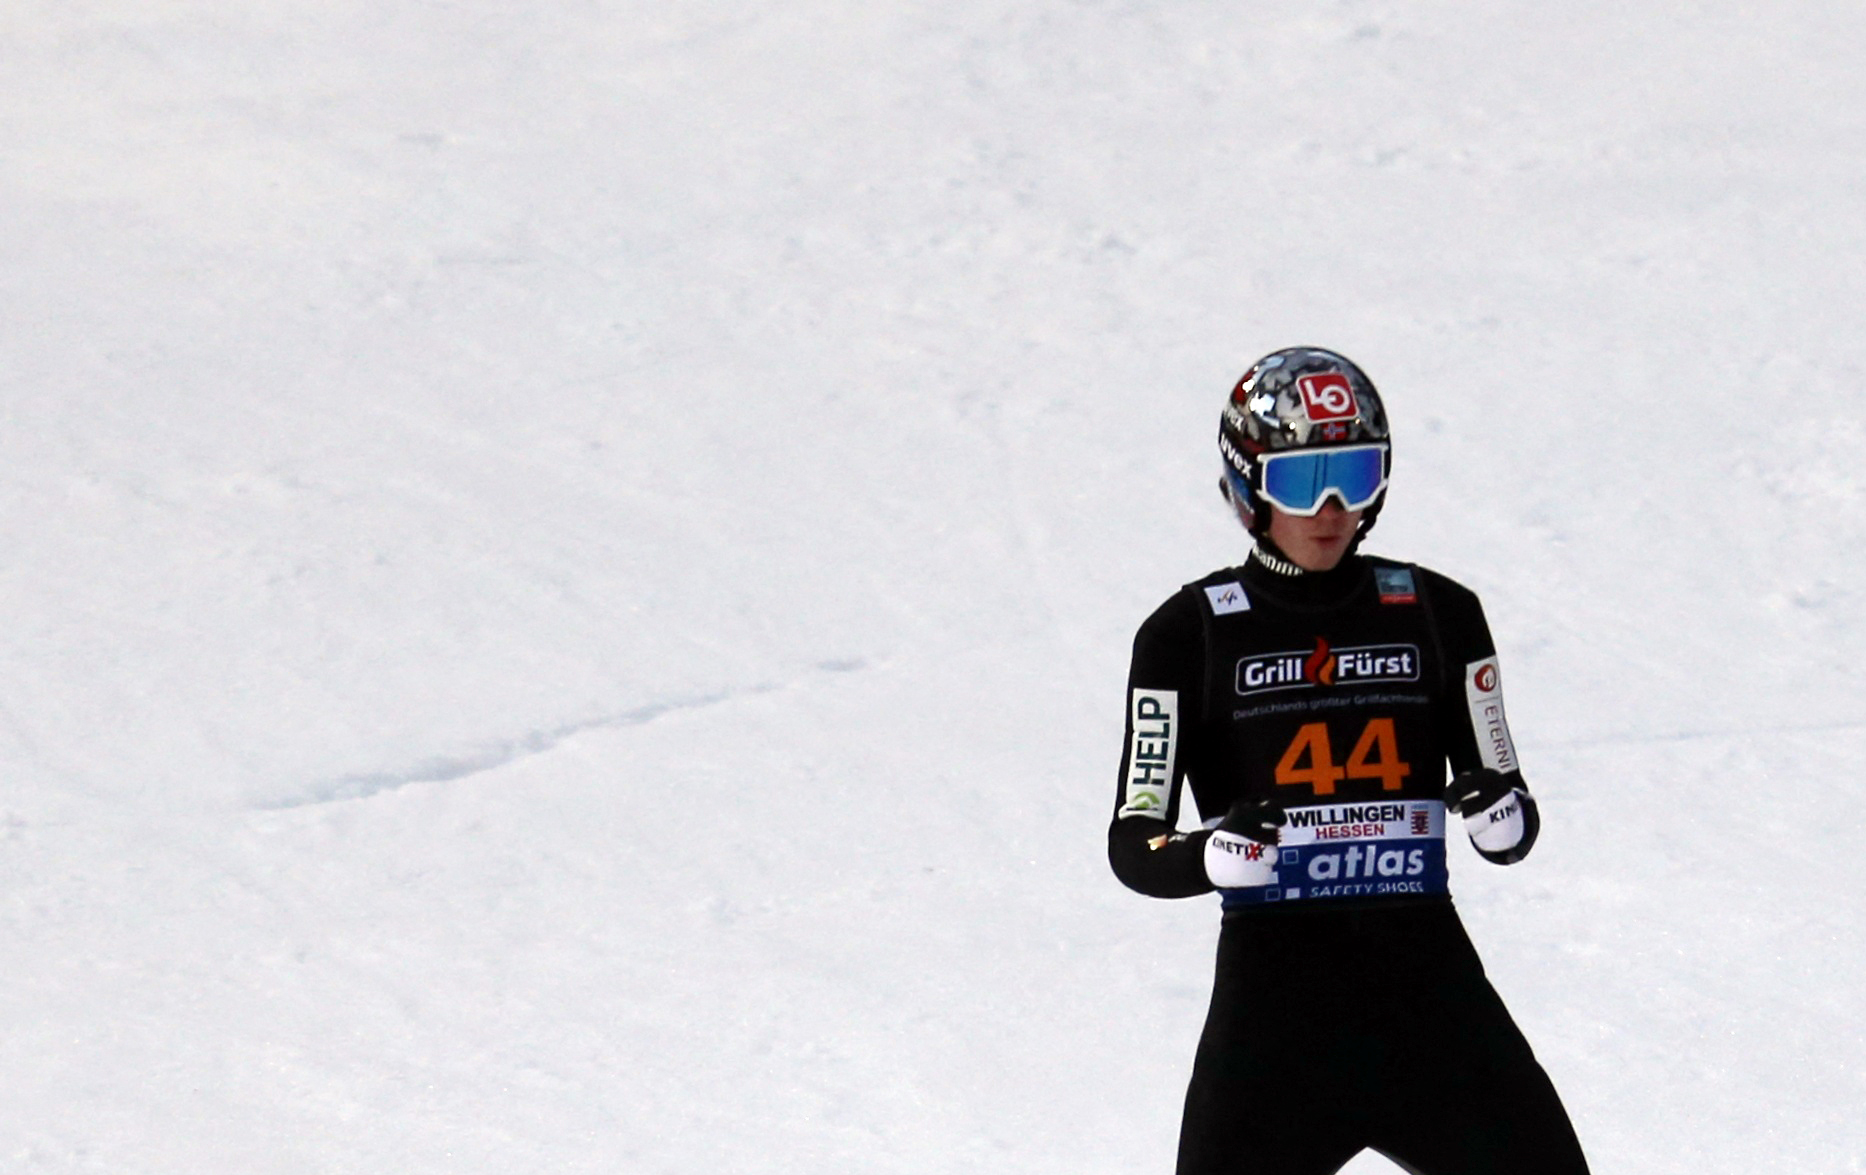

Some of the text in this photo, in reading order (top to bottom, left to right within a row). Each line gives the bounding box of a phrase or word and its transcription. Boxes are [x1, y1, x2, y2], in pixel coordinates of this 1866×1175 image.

[1219, 433, 1253, 479] uvex
[1245, 652, 1411, 686] Grill Fürst
[1132, 696, 1171, 786] HELP
[1274, 717, 1411, 797] 44
[1288, 805, 1406, 829] WILLINGEN
[1315, 823, 1385, 840] HESSEN
[1307, 844, 1425, 881] atlas
[1309, 881, 1424, 898] SAFETY SHOES
